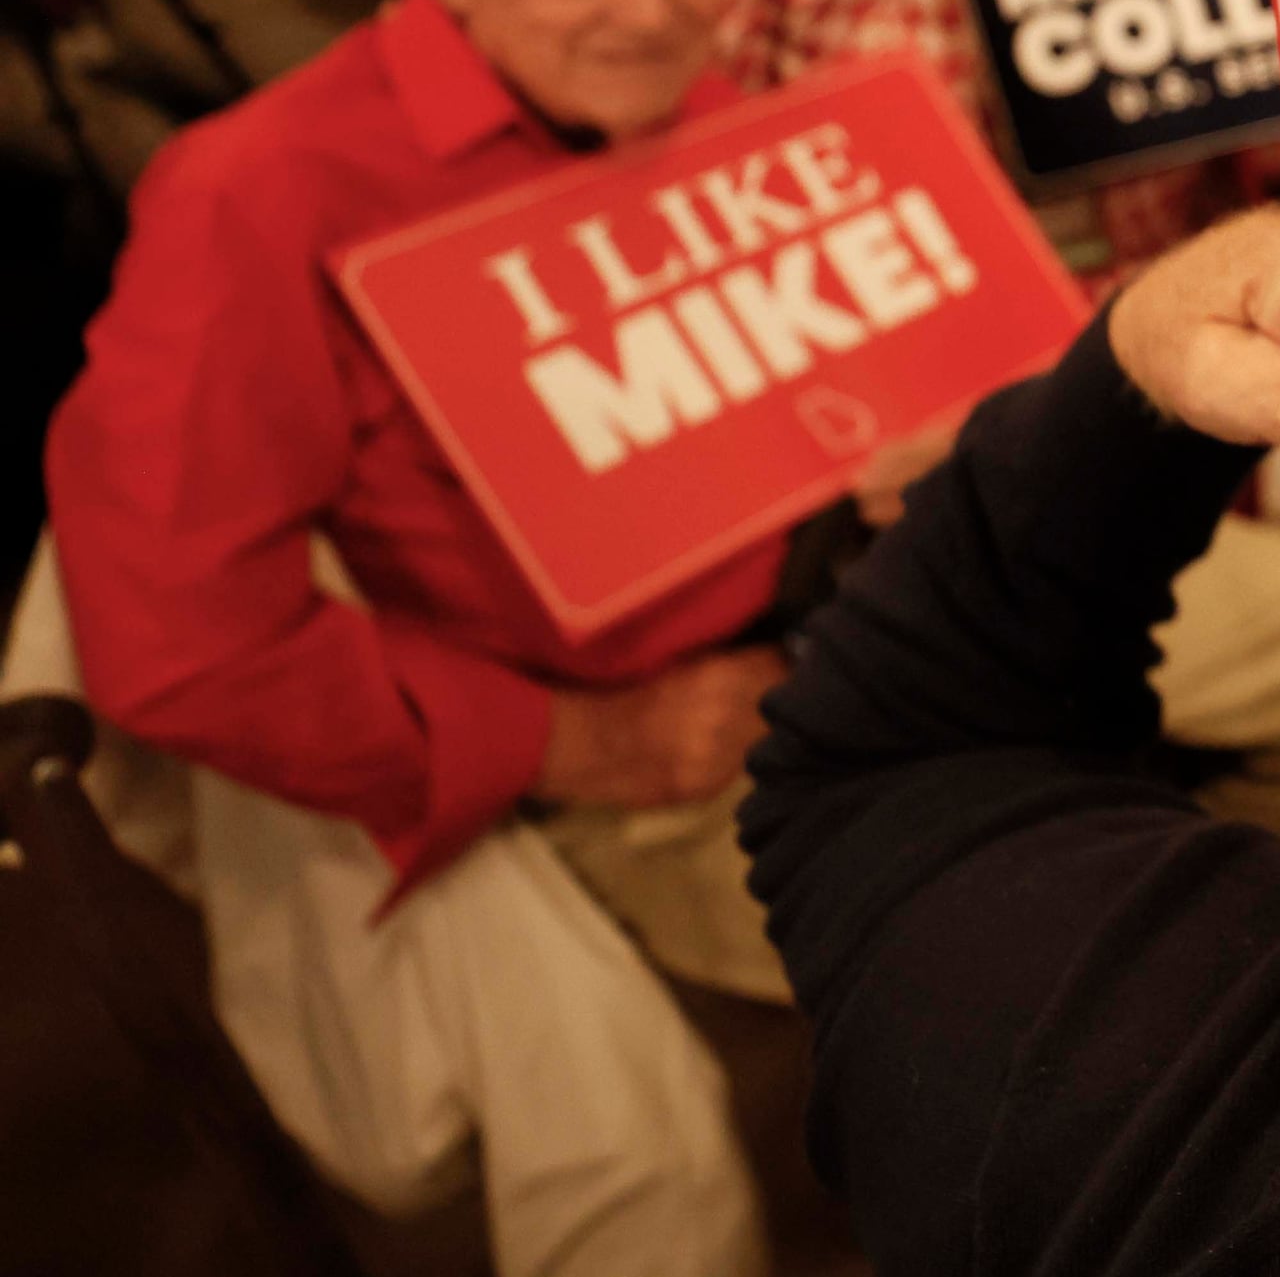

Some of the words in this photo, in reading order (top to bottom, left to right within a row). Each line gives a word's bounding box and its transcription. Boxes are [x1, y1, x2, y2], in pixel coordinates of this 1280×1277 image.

[486, 245, 572, 343] I
[570, 123, 881, 306] LIKE
[523, 187, 979, 477] MIKE!
